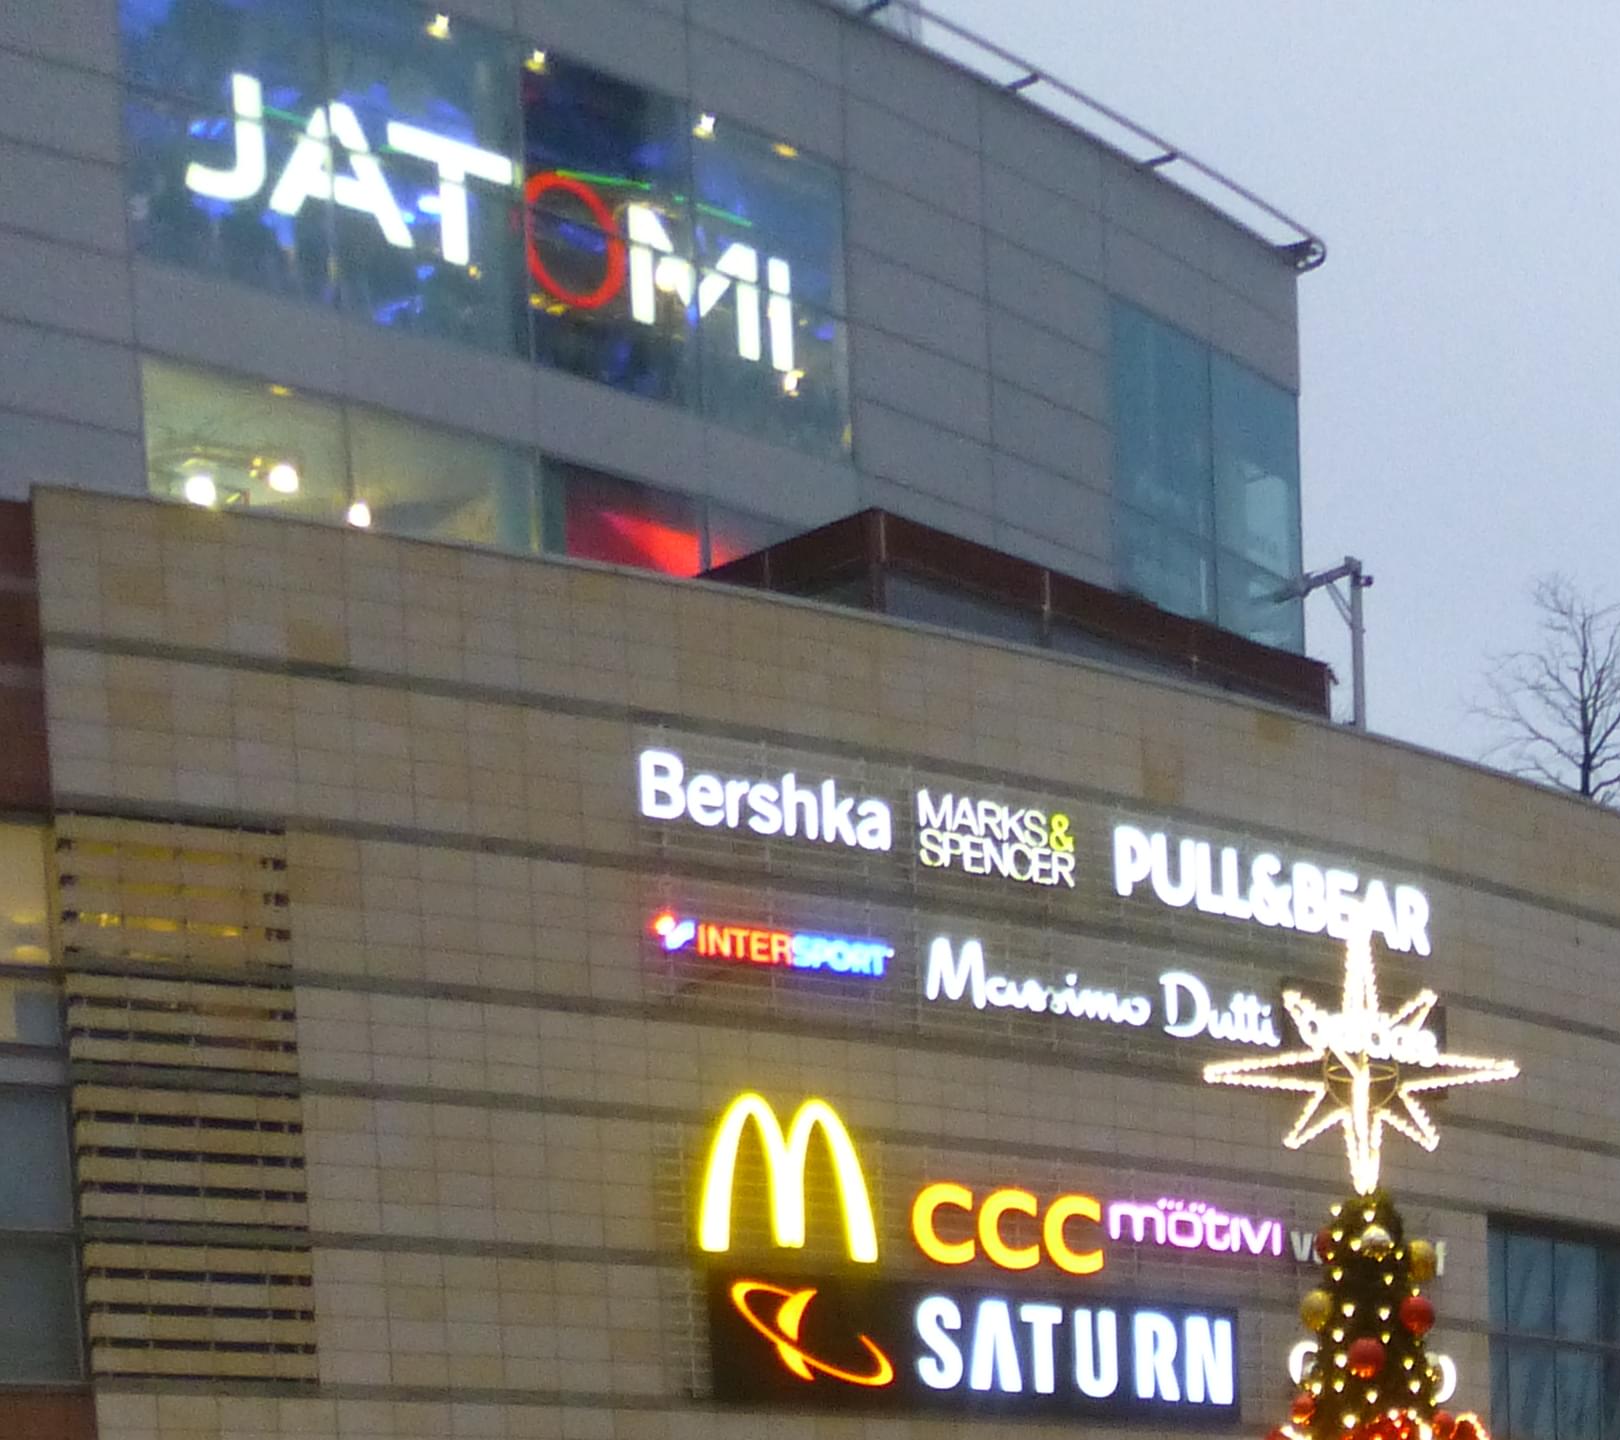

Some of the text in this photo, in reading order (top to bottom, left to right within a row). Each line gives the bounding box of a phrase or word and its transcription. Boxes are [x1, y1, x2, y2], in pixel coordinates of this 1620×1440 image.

[186, 73, 794, 372] JATOMI
[640, 750, 892, 851] Bershka
[919, 829, 1076, 888] SPENCER
[1111, 825, 1432, 956] PULL&BEAR
[697, 927, 890, 977] INTERSPORT
[925, 937, 1280, 1048] Massimo Dutti
[910, 1182, 1107, 1275] CCC
[917, 1298, 1234, 1406] SATURN
